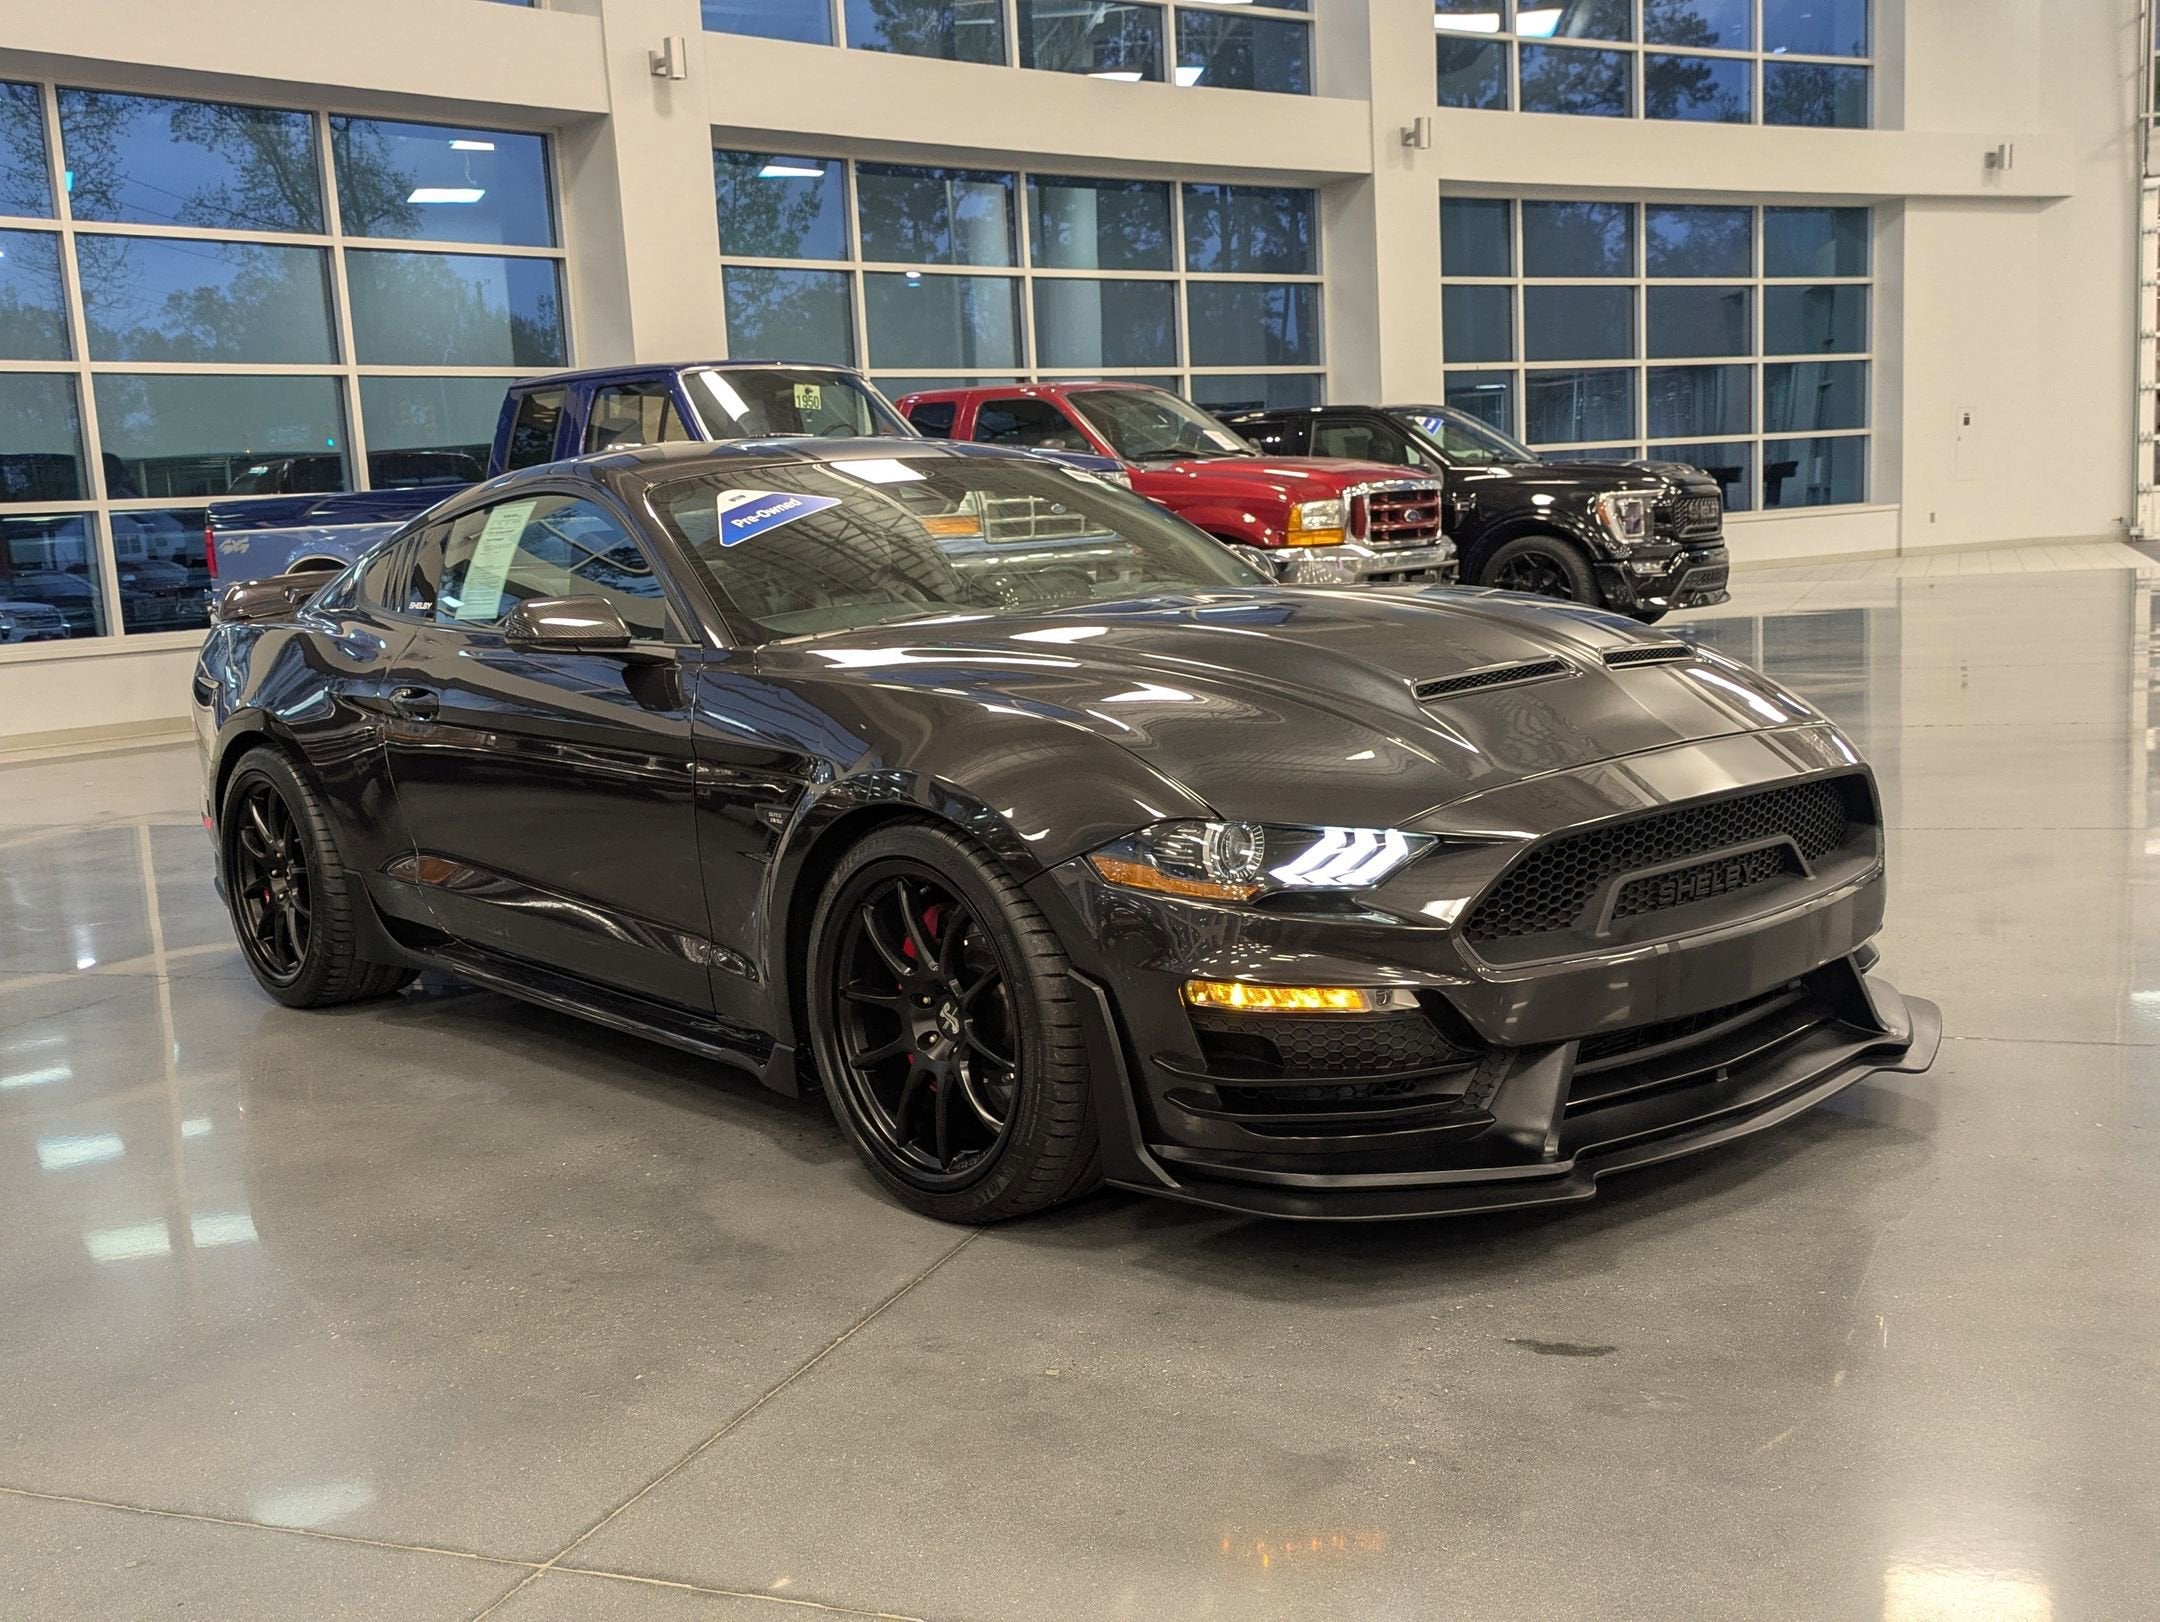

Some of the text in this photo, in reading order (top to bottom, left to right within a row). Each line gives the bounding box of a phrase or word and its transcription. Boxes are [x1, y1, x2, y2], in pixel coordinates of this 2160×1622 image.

[796, 394, 820, 409] 1950
[731, 498, 803, 528] Pre-Owned
[409, 601, 433, 610] SHELBY
[1658, 861, 1752, 906] SHELBY
